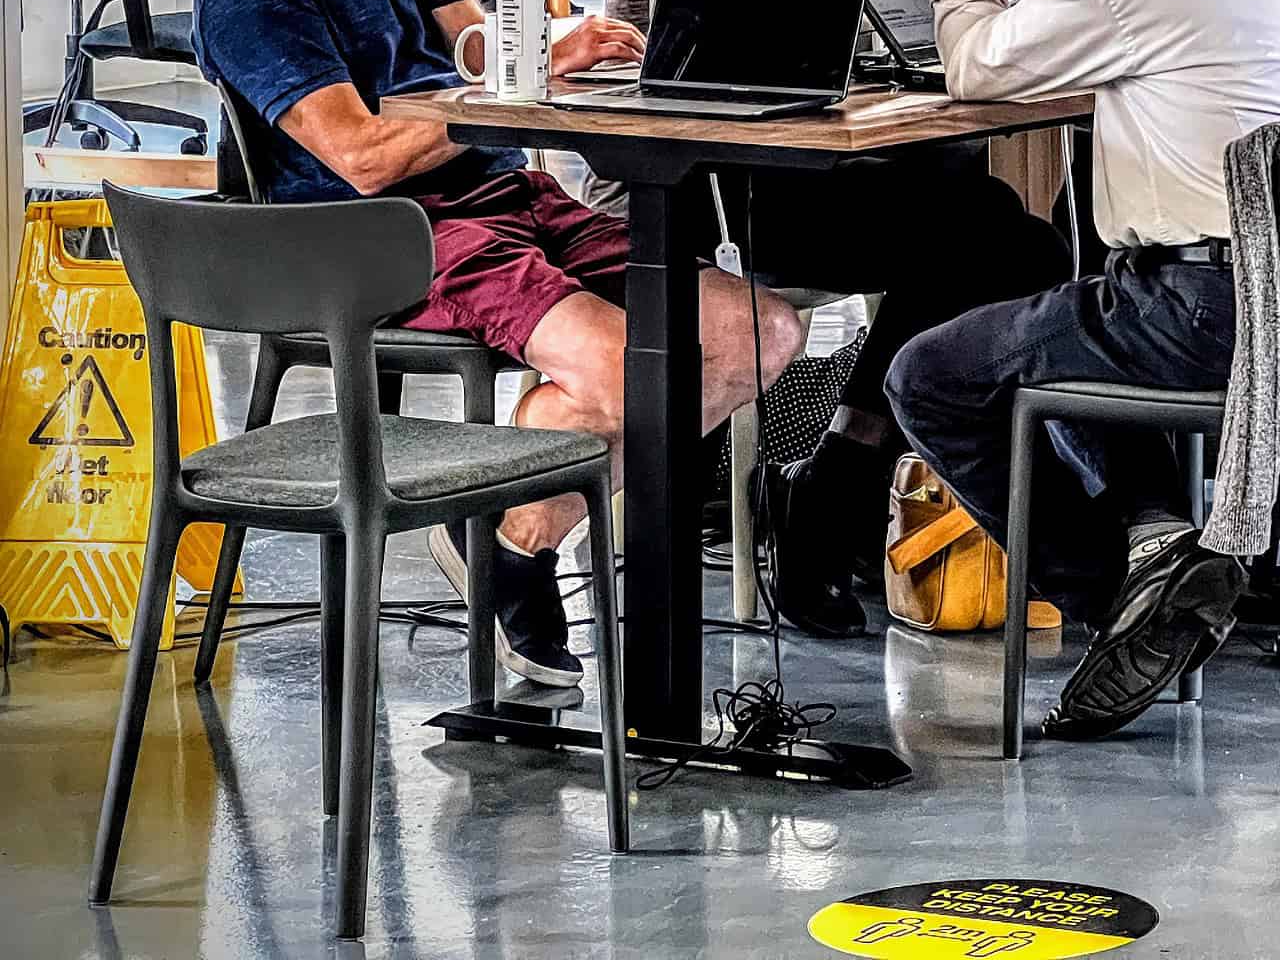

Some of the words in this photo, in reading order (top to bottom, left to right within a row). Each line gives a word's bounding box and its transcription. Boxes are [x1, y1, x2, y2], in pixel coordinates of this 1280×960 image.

[37, 326, 146, 350] Caution
[931, 888, 1023, 904] KEEP
[1028, 899, 1120, 918] YOUR
[981, 883, 1113, 905] PLEASE
[922, 899, 1088, 926] DISTANCE
